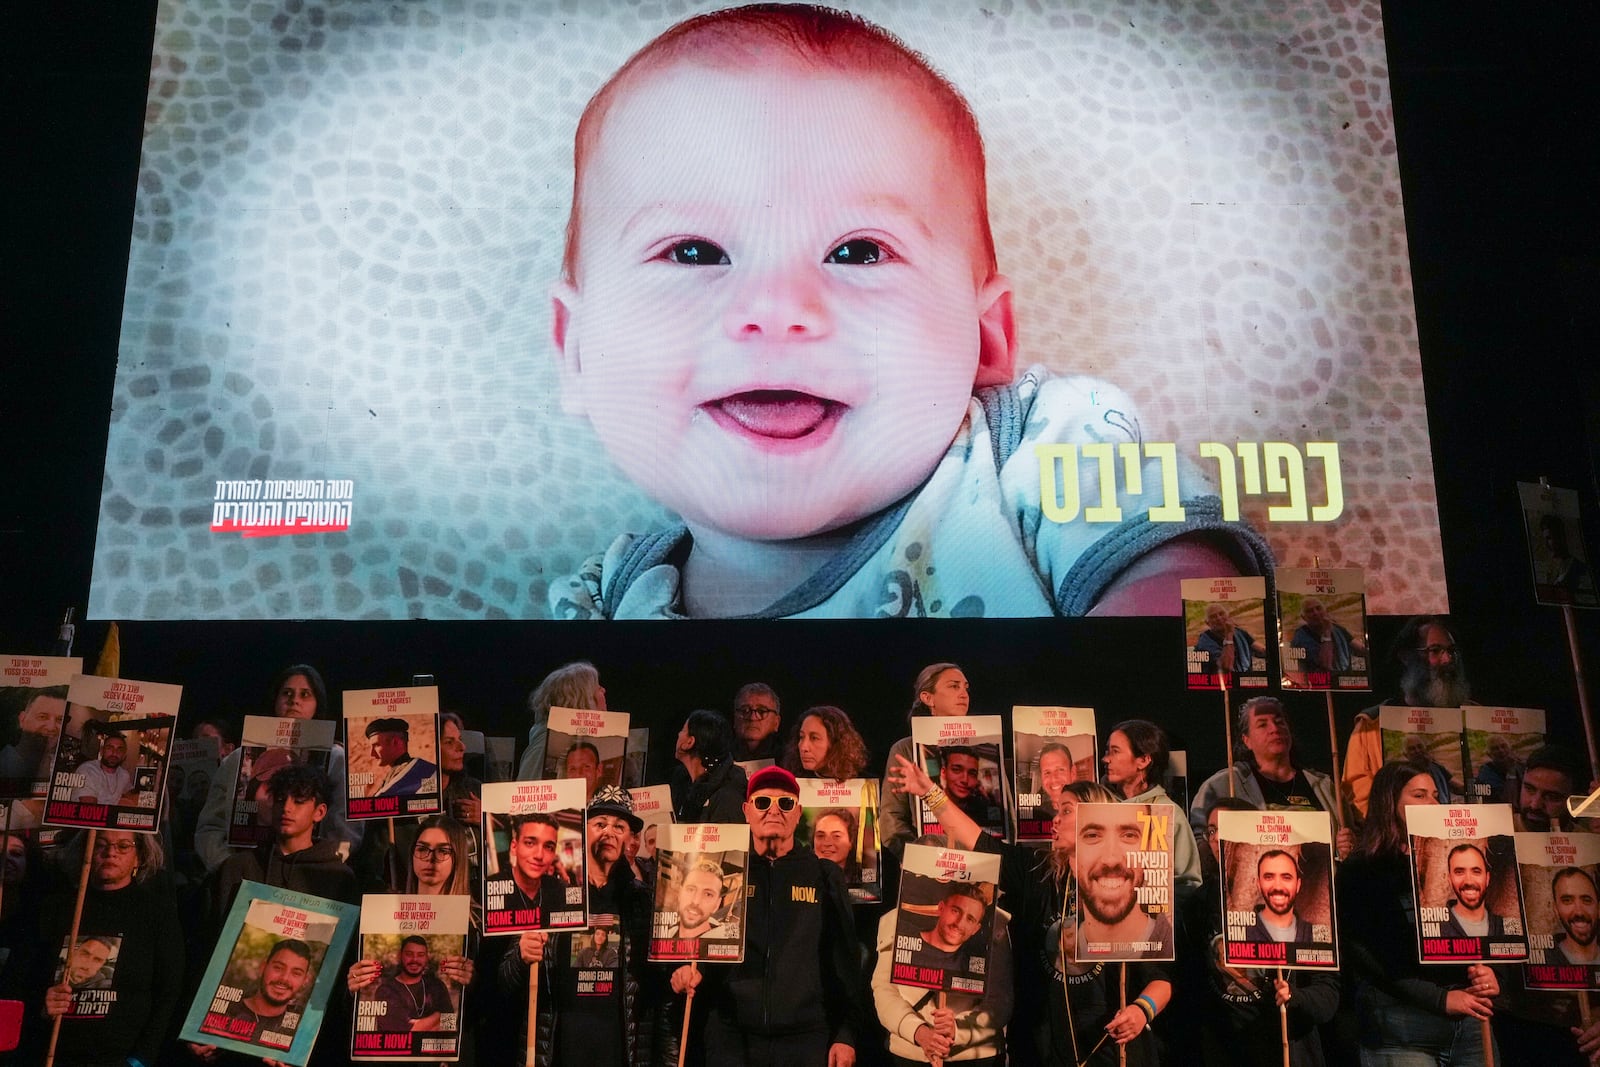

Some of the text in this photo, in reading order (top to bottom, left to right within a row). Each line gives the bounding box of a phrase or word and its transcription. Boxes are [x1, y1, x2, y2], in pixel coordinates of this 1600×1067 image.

[214, 479, 353, 500] מטה המשפחות להחזרת
[1035, 442, 1344, 523] כפיר ביבס
[212, 501, 352, 526] החטופים והנעדרים
[1187, 651, 1210, 662] BRING
[1187, 662, 1202, 673] HIM
[1188, 673, 1209, 685] HOME
[103, 691, 145, 703] SEGEV KALFON
[54, 772, 86, 788] BRING
[349, 772, 374, 785] BRING
[51, 786, 73, 802] HIM
[349, 785, 365, 798] HIM
[512, 793, 558, 803] EDAN ALEXANDER
[349, 799, 373, 812] HOME
[375, 796, 399, 811] NOW!
[1018, 793, 1041, 806] BRING
[49, 802, 110, 821] HOME NOW!
[1018, 806, 1034, 819] HIM
[1256, 825, 1292, 833] TAL SHOHAM
[1444, 818, 1478, 827] TAL SHOHAM
[1136, 810, 1169, 851] אל
[1544, 846, 1555, 854] TAL
[1126, 851, 1169, 869] תשאירו
[959, 871, 972, 880] 31
[1143, 869, 1168, 886] אותי
[487, 880, 514, 895] BRING
[791, 885, 818, 903] NOW.
[487, 895, 505, 910] HIM
[1133, 886, 1168, 905] מאחור
[394, 912, 436, 920] OMER WENKERT
[487, 906, 541, 926] HOME NOW!
[653, 911, 678, 925] BRING
[1227, 911, 1256, 926] BRING
[1420, 907, 1450, 922] BRING
[652, 925, 669, 938] HIM
[1228, 926, 1246, 941] HIM
[1422, 922, 1441, 937] HIM
[650, 939, 674, 953] HOME
[676, 939, 700, 953] NOW!
[896, 935, 922, 952] BRING
[1423, 938, 1481, 954] HOME NOW!
[1530, 934, 1554, 949] RING
[895, 949, 912, 964] HIM
[1228, 941, 1286, 958] HOME NOW!
[578, 970, 613, 981] BRING EDAN
[894, 964, 917, 980] HOME
[919, 969, 944, 984] NOW!
[1069, 972, 1094, 985] HOME
[1559, 964, 1588, 982] NOW!
[215, 984, 244, 1003] BRING
[577, 981, 595, 992] HOME
[79, 989, 118, 1002] מחזירים
[76, 1001, 110, 1015] הביתה
[209, 998, 230, 1014] HIM
[358, 1000, 388, 1016] BRING
[203, 1013, 257, 1037] HOME NOW!
[357, 1016, 377, 1031] HIM
[355, 1032, 413, 1049] HOME NOW!
